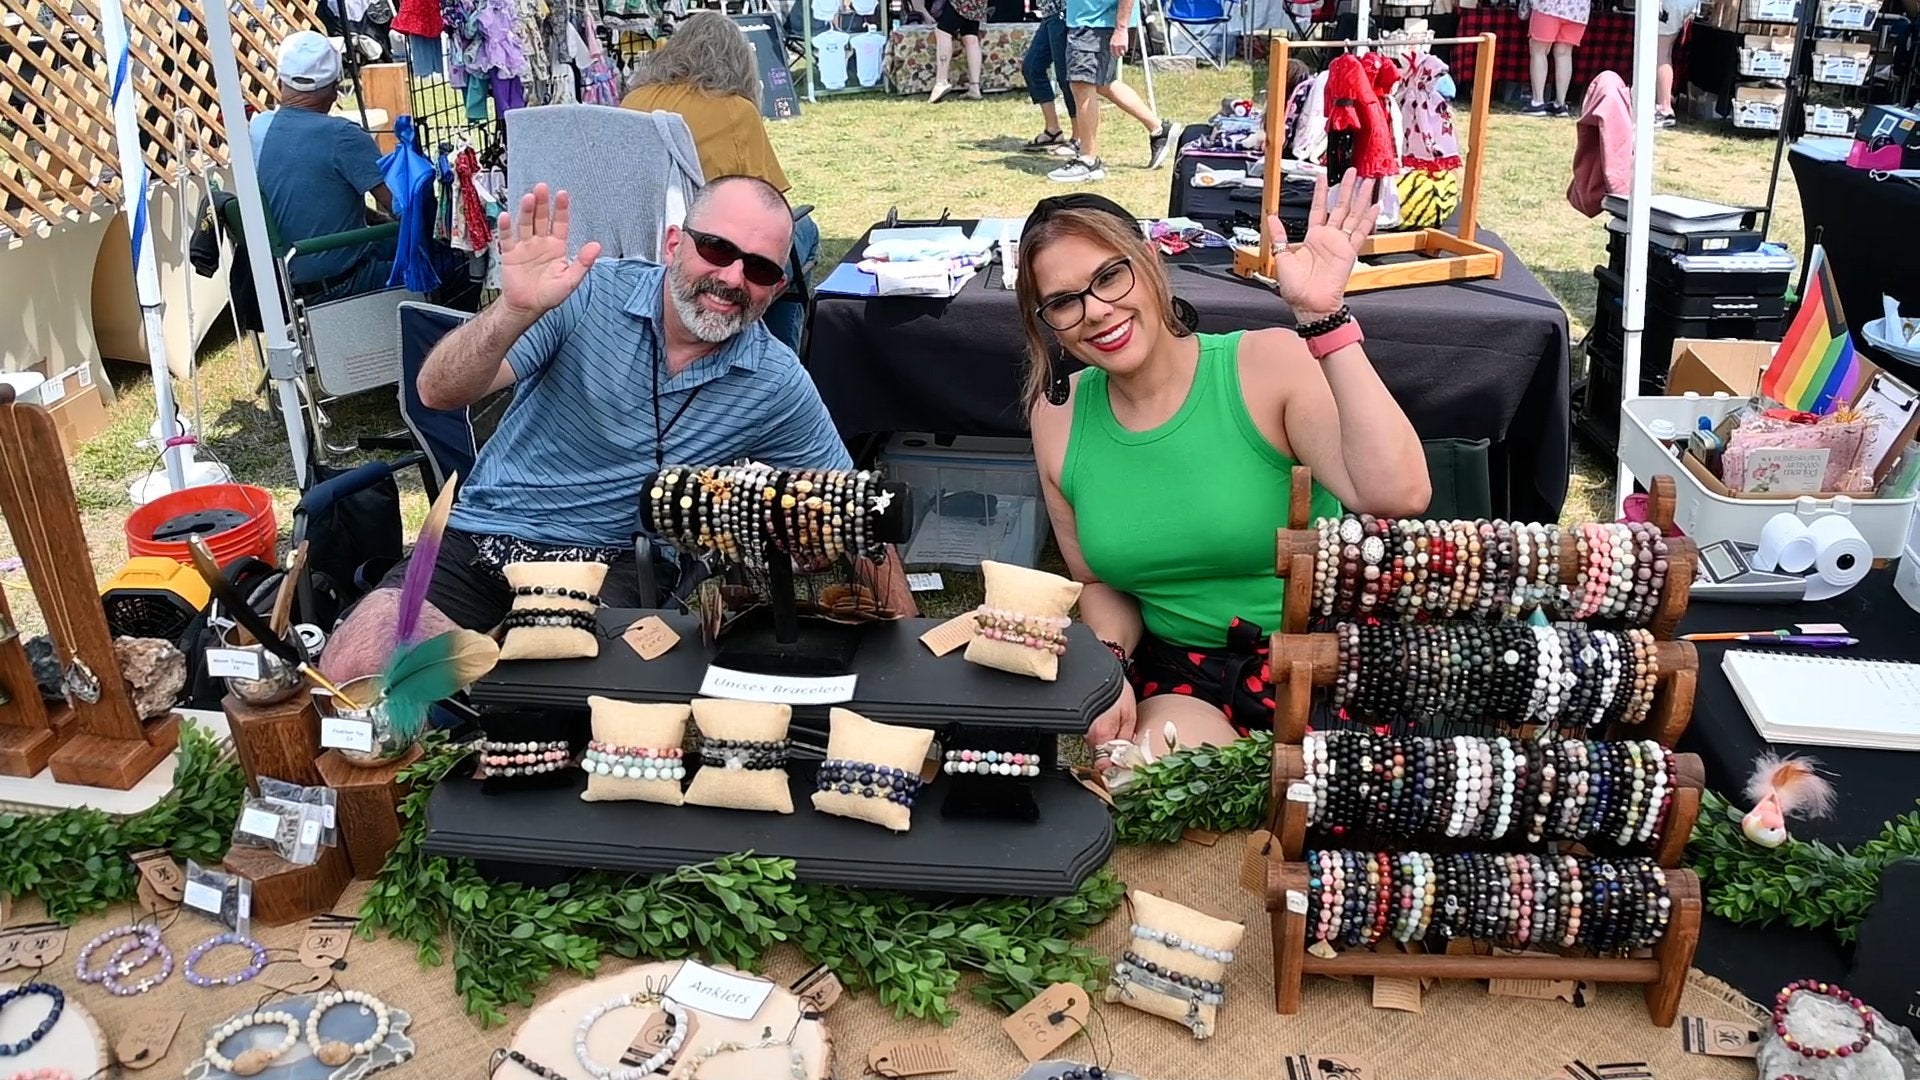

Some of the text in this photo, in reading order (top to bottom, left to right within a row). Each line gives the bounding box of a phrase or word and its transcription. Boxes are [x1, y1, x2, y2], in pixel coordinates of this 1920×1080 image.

[714, 677, 845, 694] Unisex Bracelets
[688, 980, 750, 1004] Anklets
